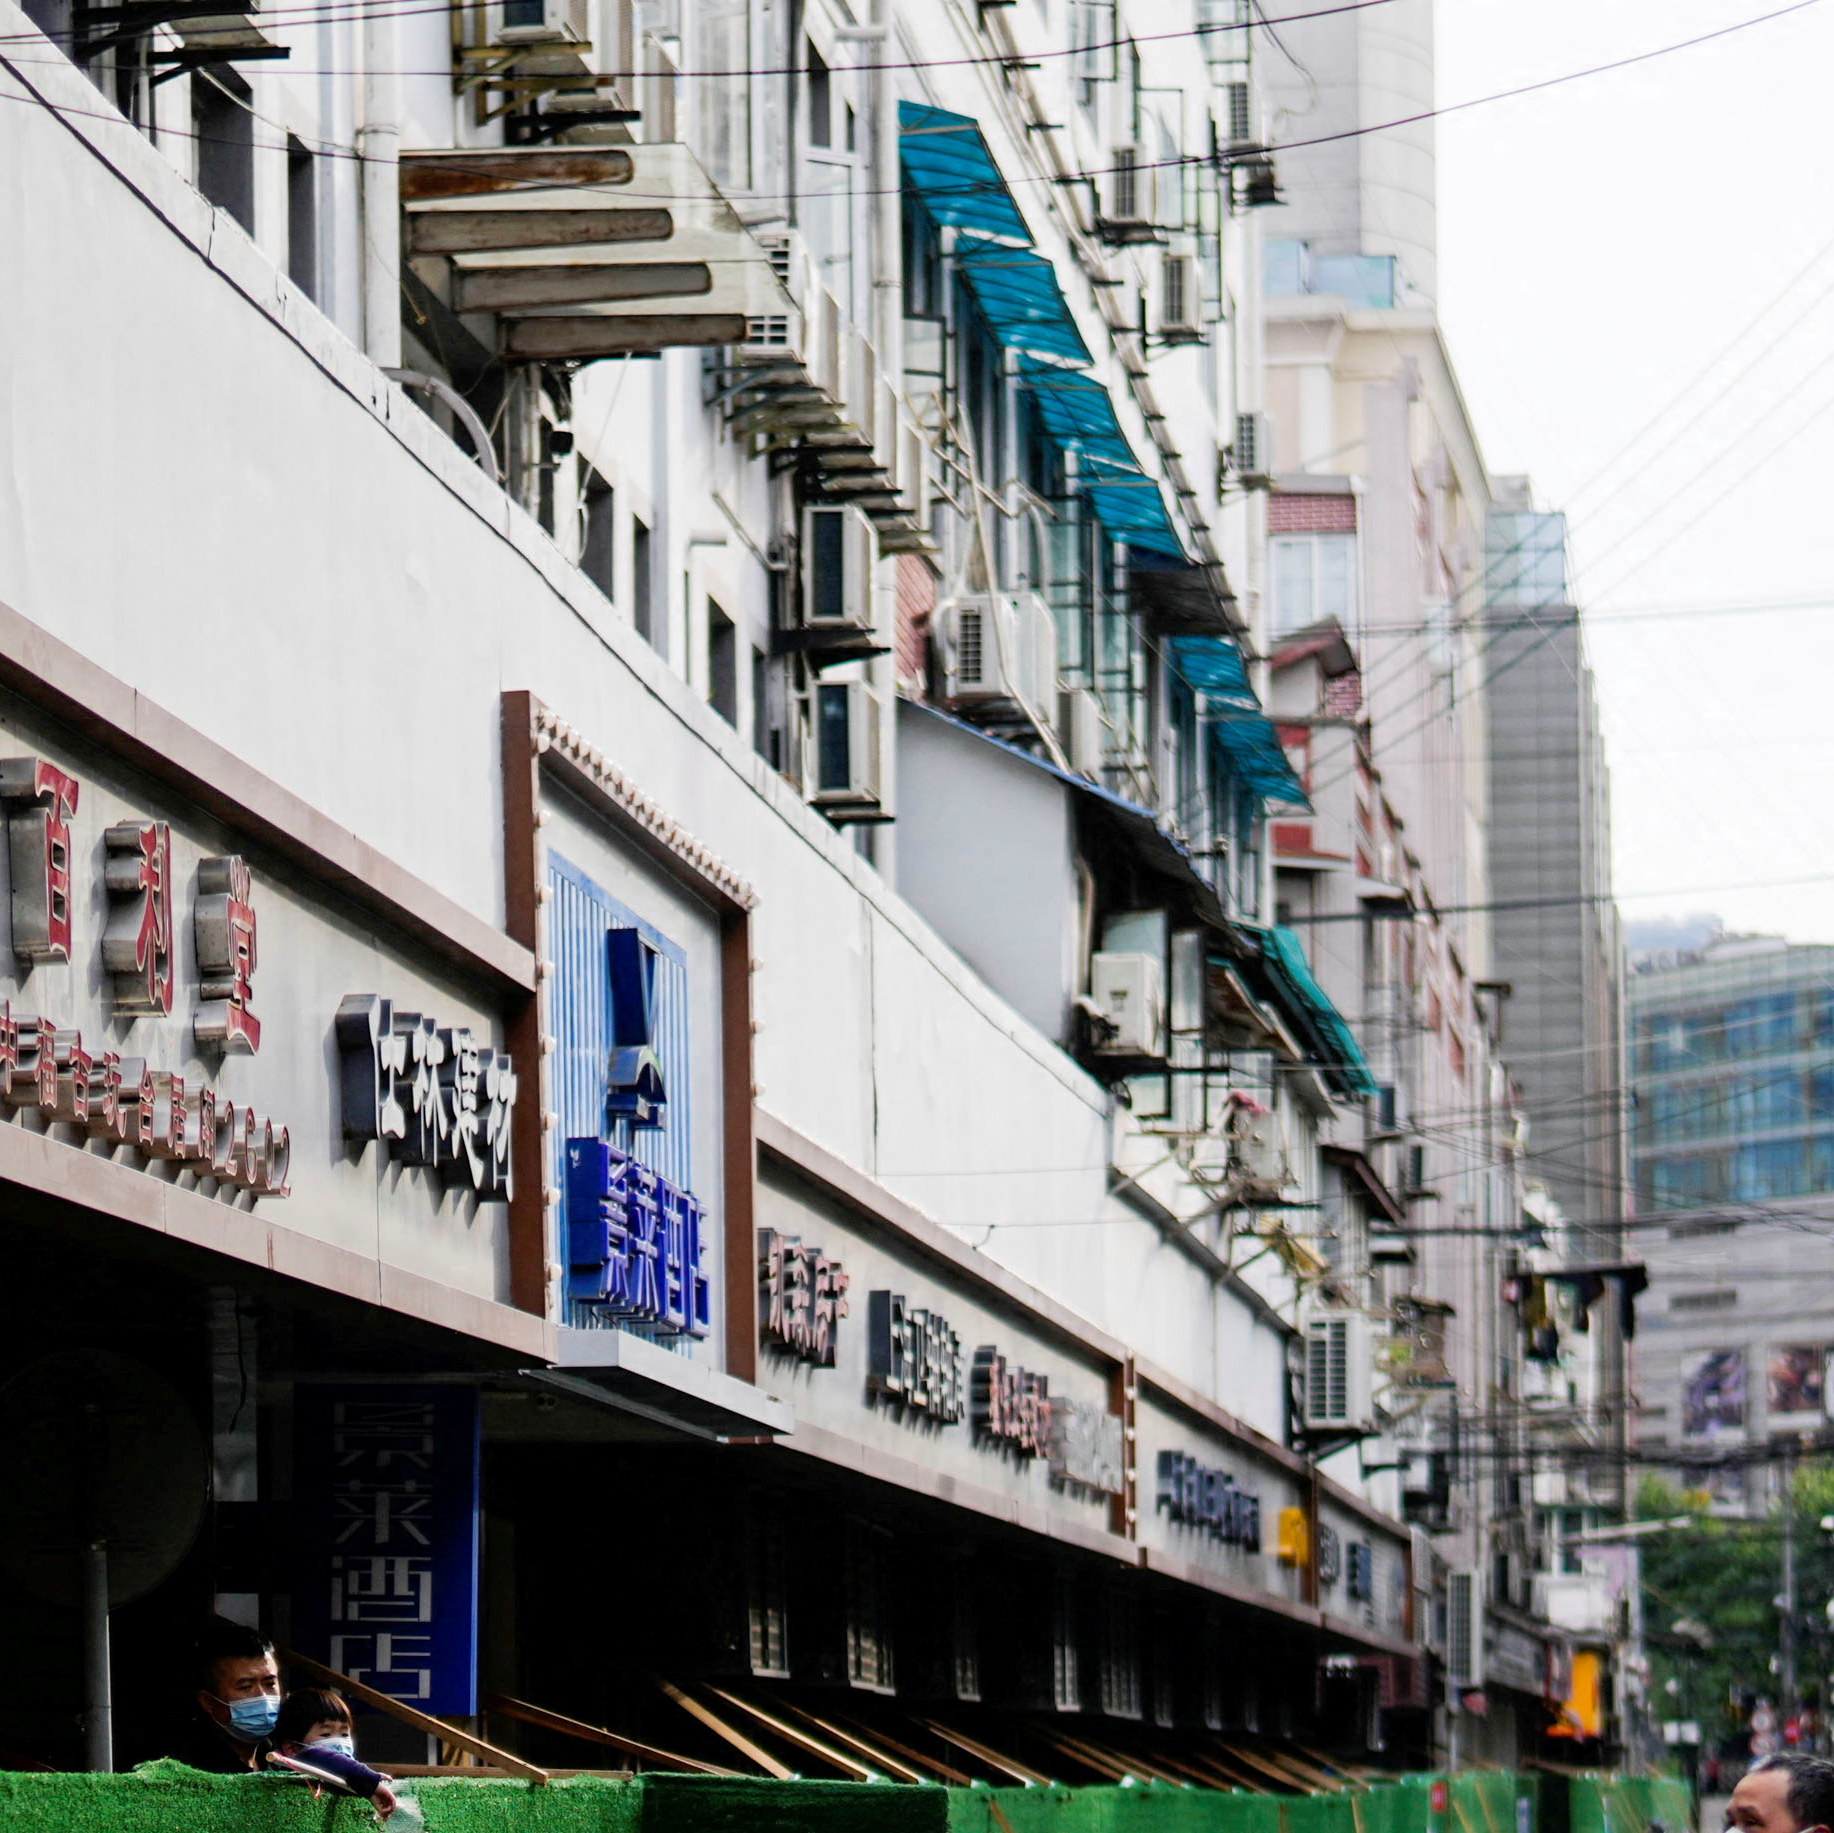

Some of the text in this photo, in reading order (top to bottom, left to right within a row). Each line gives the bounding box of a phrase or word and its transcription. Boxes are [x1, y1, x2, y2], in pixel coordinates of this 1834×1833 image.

[33, 756, 262, 1055] 百利堂
[377, 993, 517, 1202] 仕林建材
